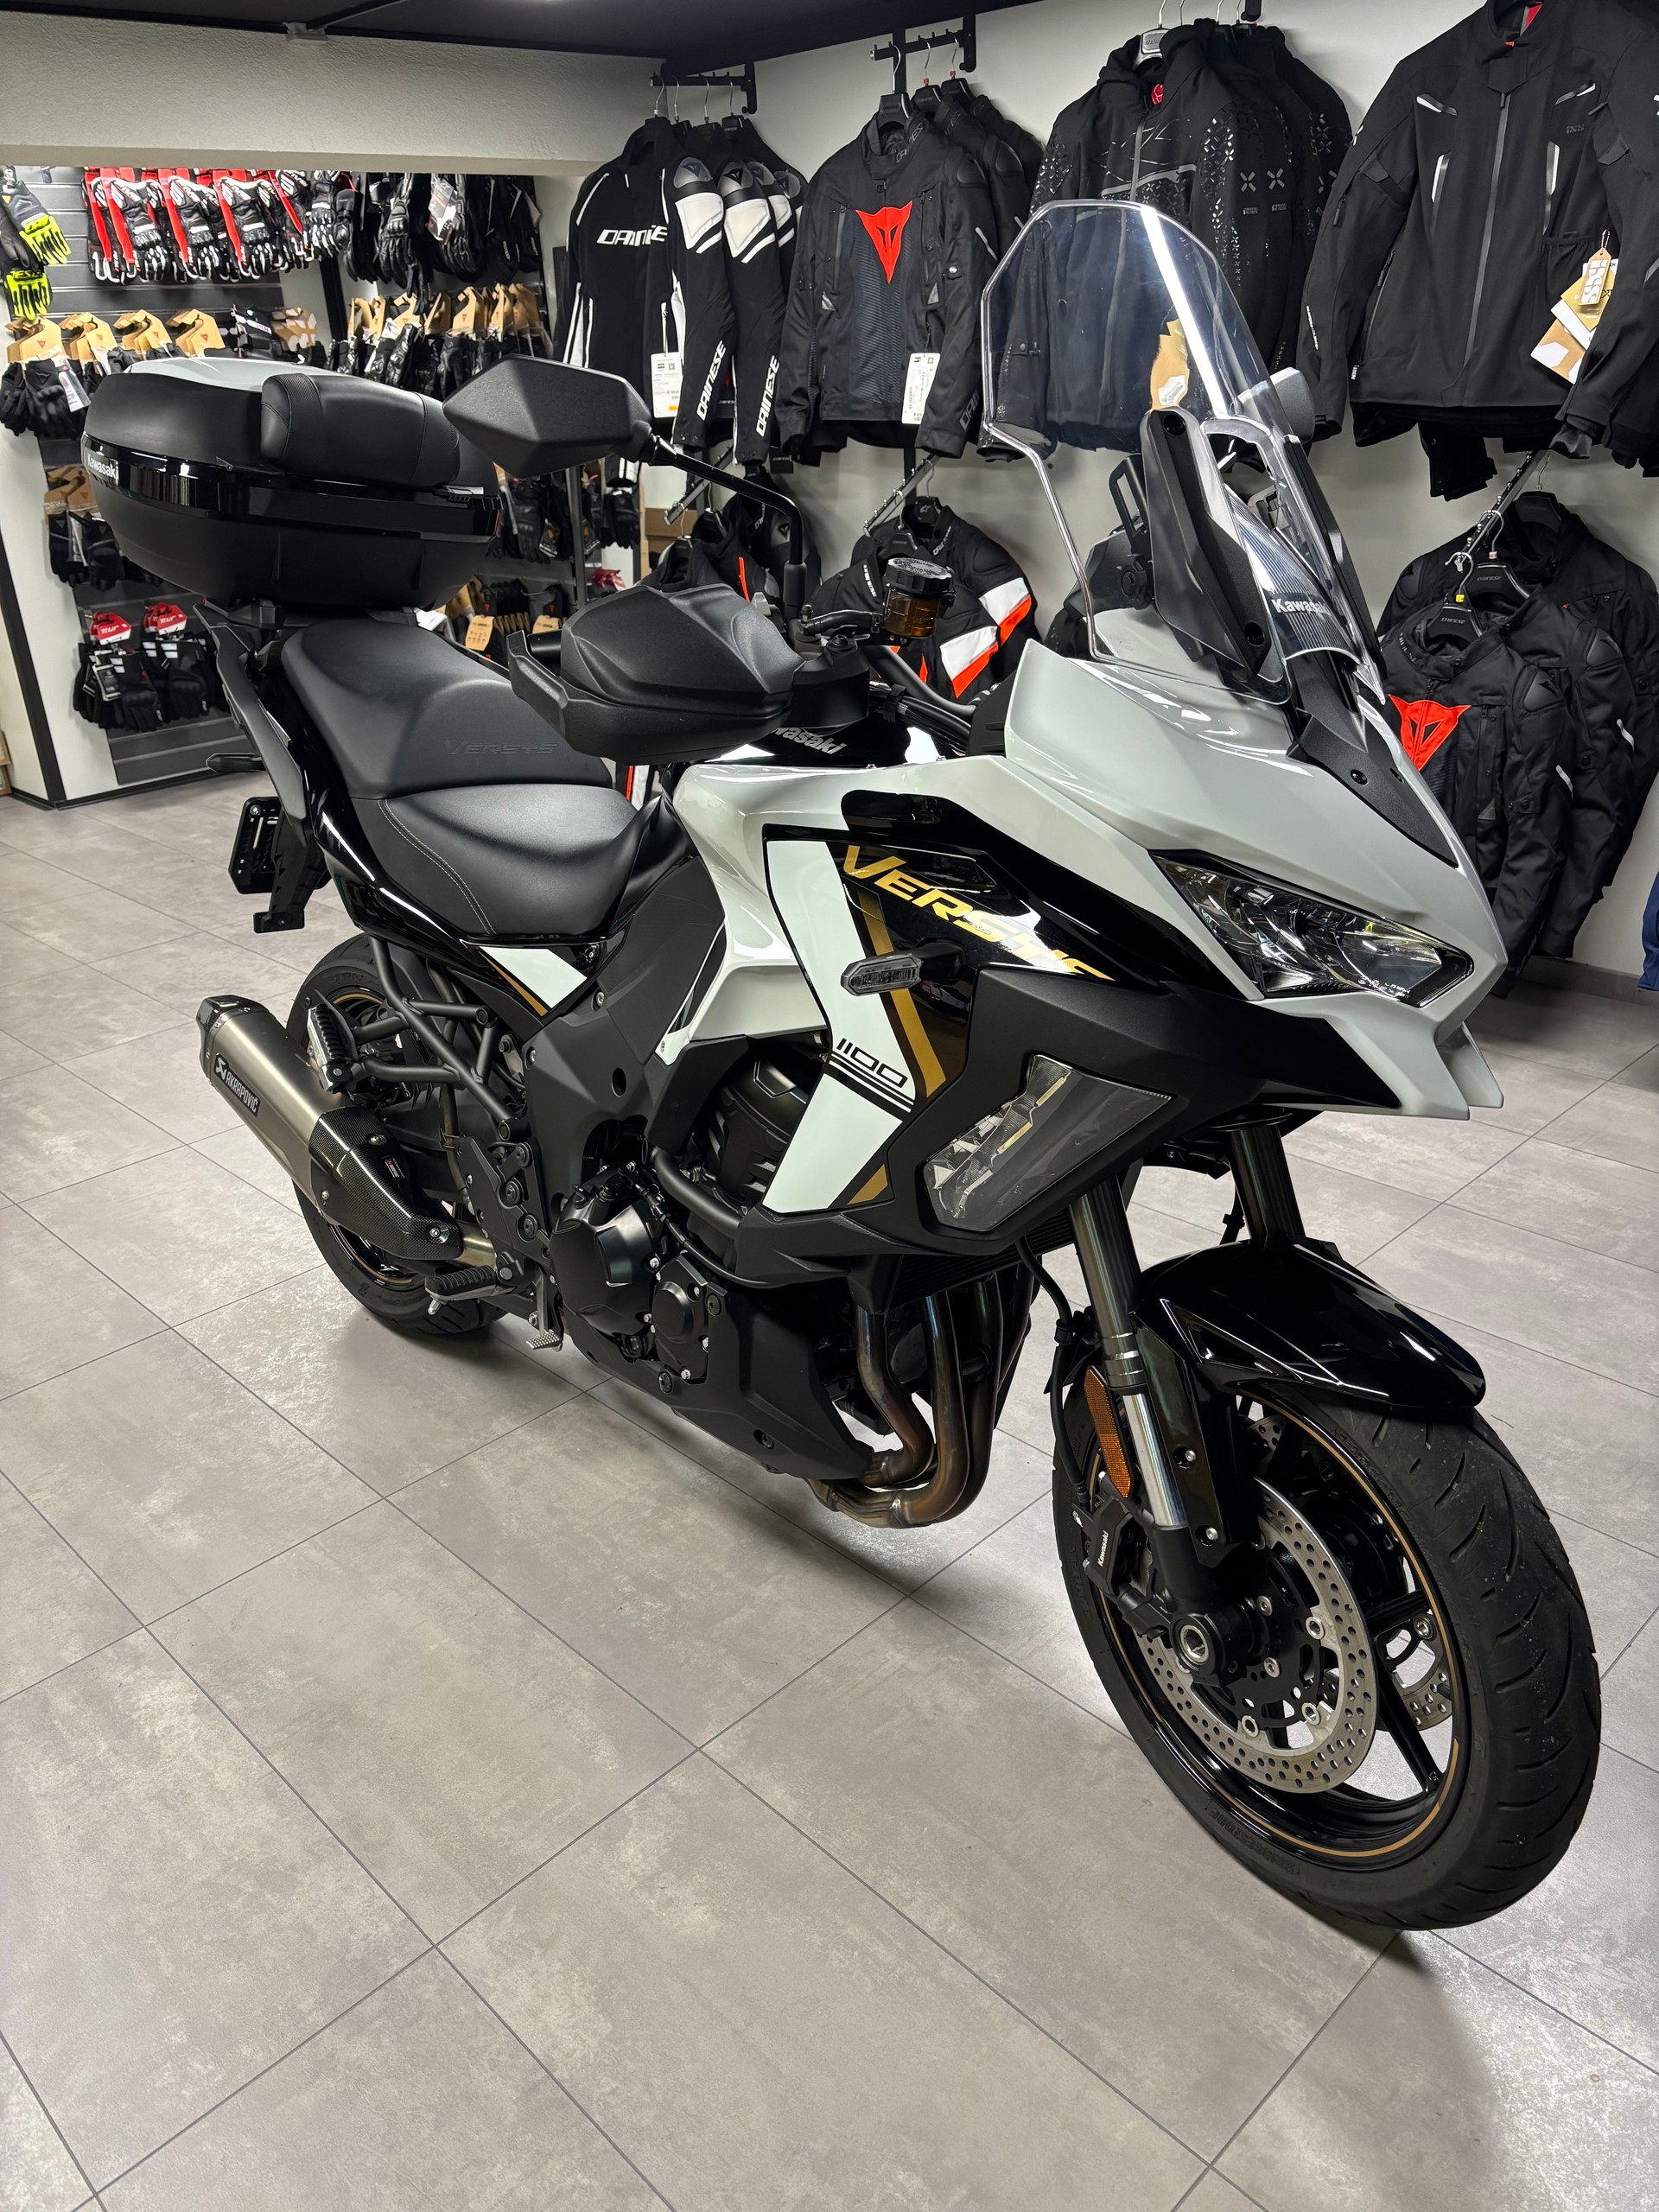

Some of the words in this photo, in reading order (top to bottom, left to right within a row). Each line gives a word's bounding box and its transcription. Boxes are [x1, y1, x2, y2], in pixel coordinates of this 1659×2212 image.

[696, 340, 727, 421] DAINESE
[756, 355, 780, 437] DAINESE
[86, 452, 119, 480] Kawasaki
[442, 739, 558, 755] VERSYS
[836, 1038, 908, 1089] 1100
[1096, 1529, 1109, 1567] Kawasaki
